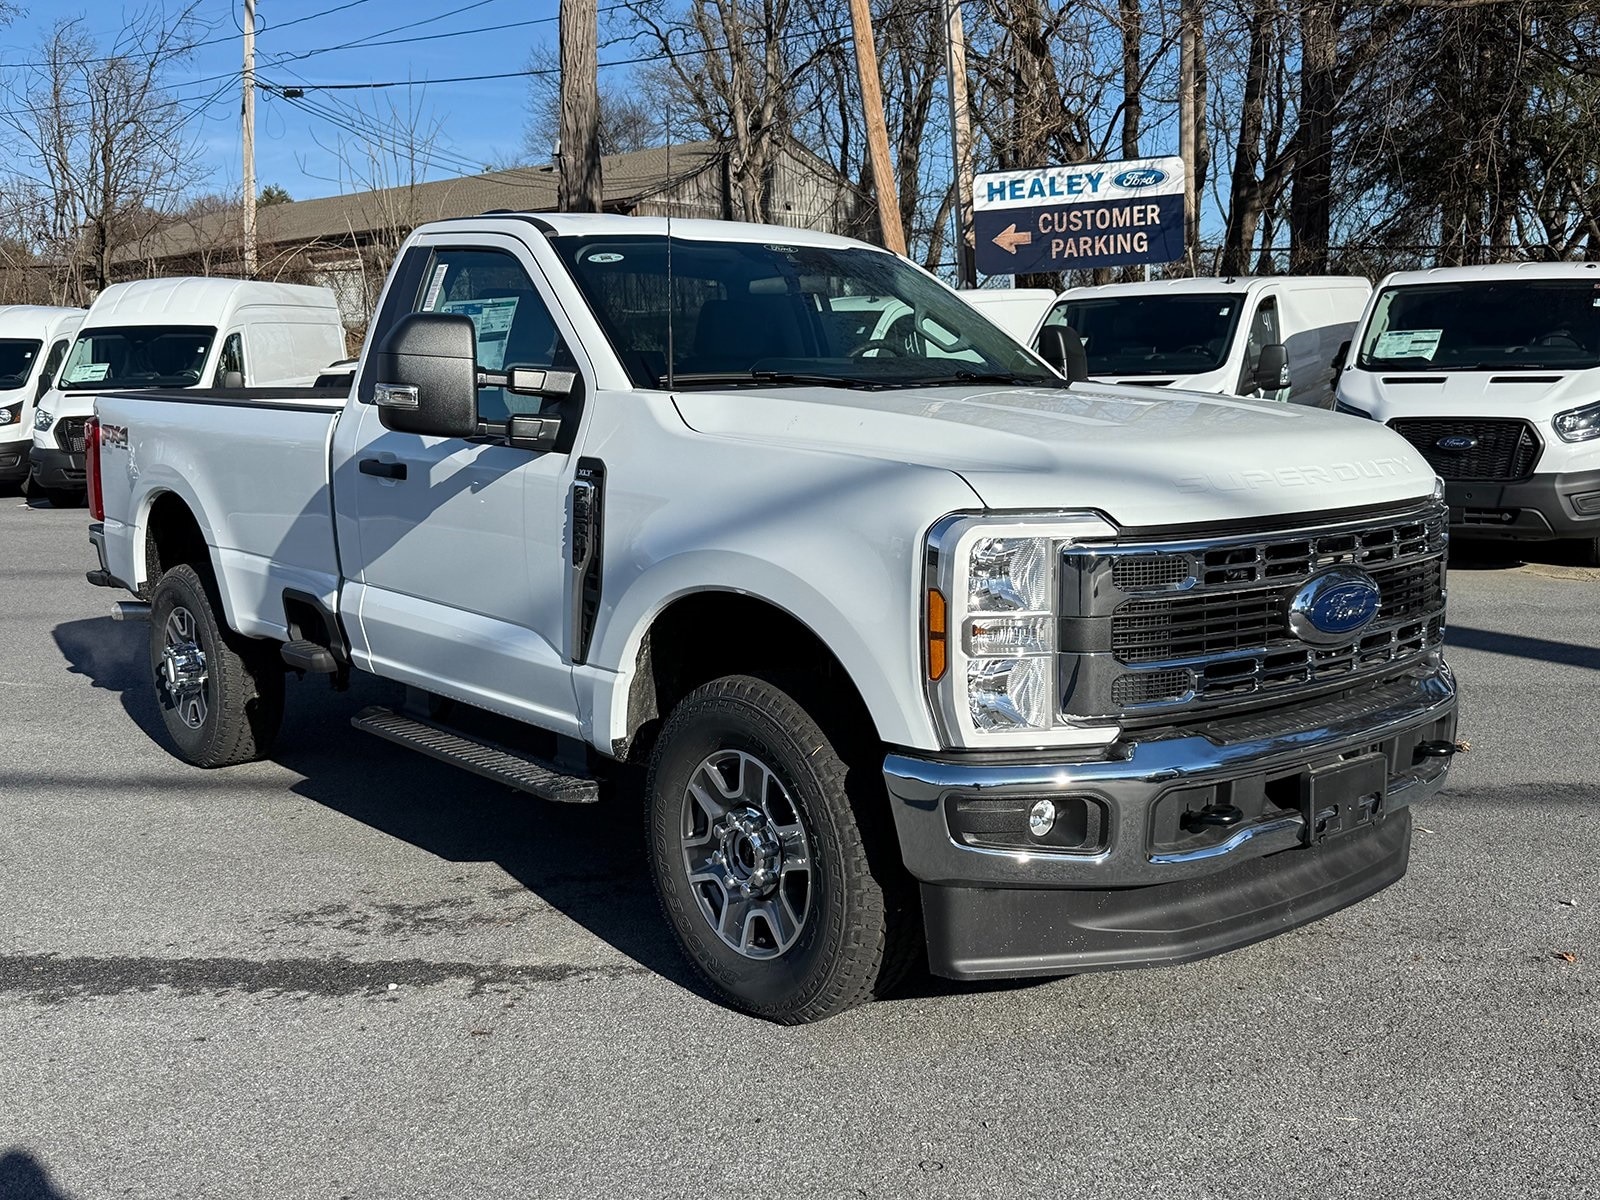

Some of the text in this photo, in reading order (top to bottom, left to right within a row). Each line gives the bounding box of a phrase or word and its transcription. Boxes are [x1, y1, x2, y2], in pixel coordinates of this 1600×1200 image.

[987, 170, 1156, 202] HEALEY Ford
[1038, 204, 1160, 234] CUSTOMER
[1051, 231, 1148, 259] PARKING
[101, 423, 129, 446] FX4
[578, 468, 592, 476] XLT
[1173, 456, 1412, 493] SUPER DUTY
[1325, 590, 1371, 622] Ford
